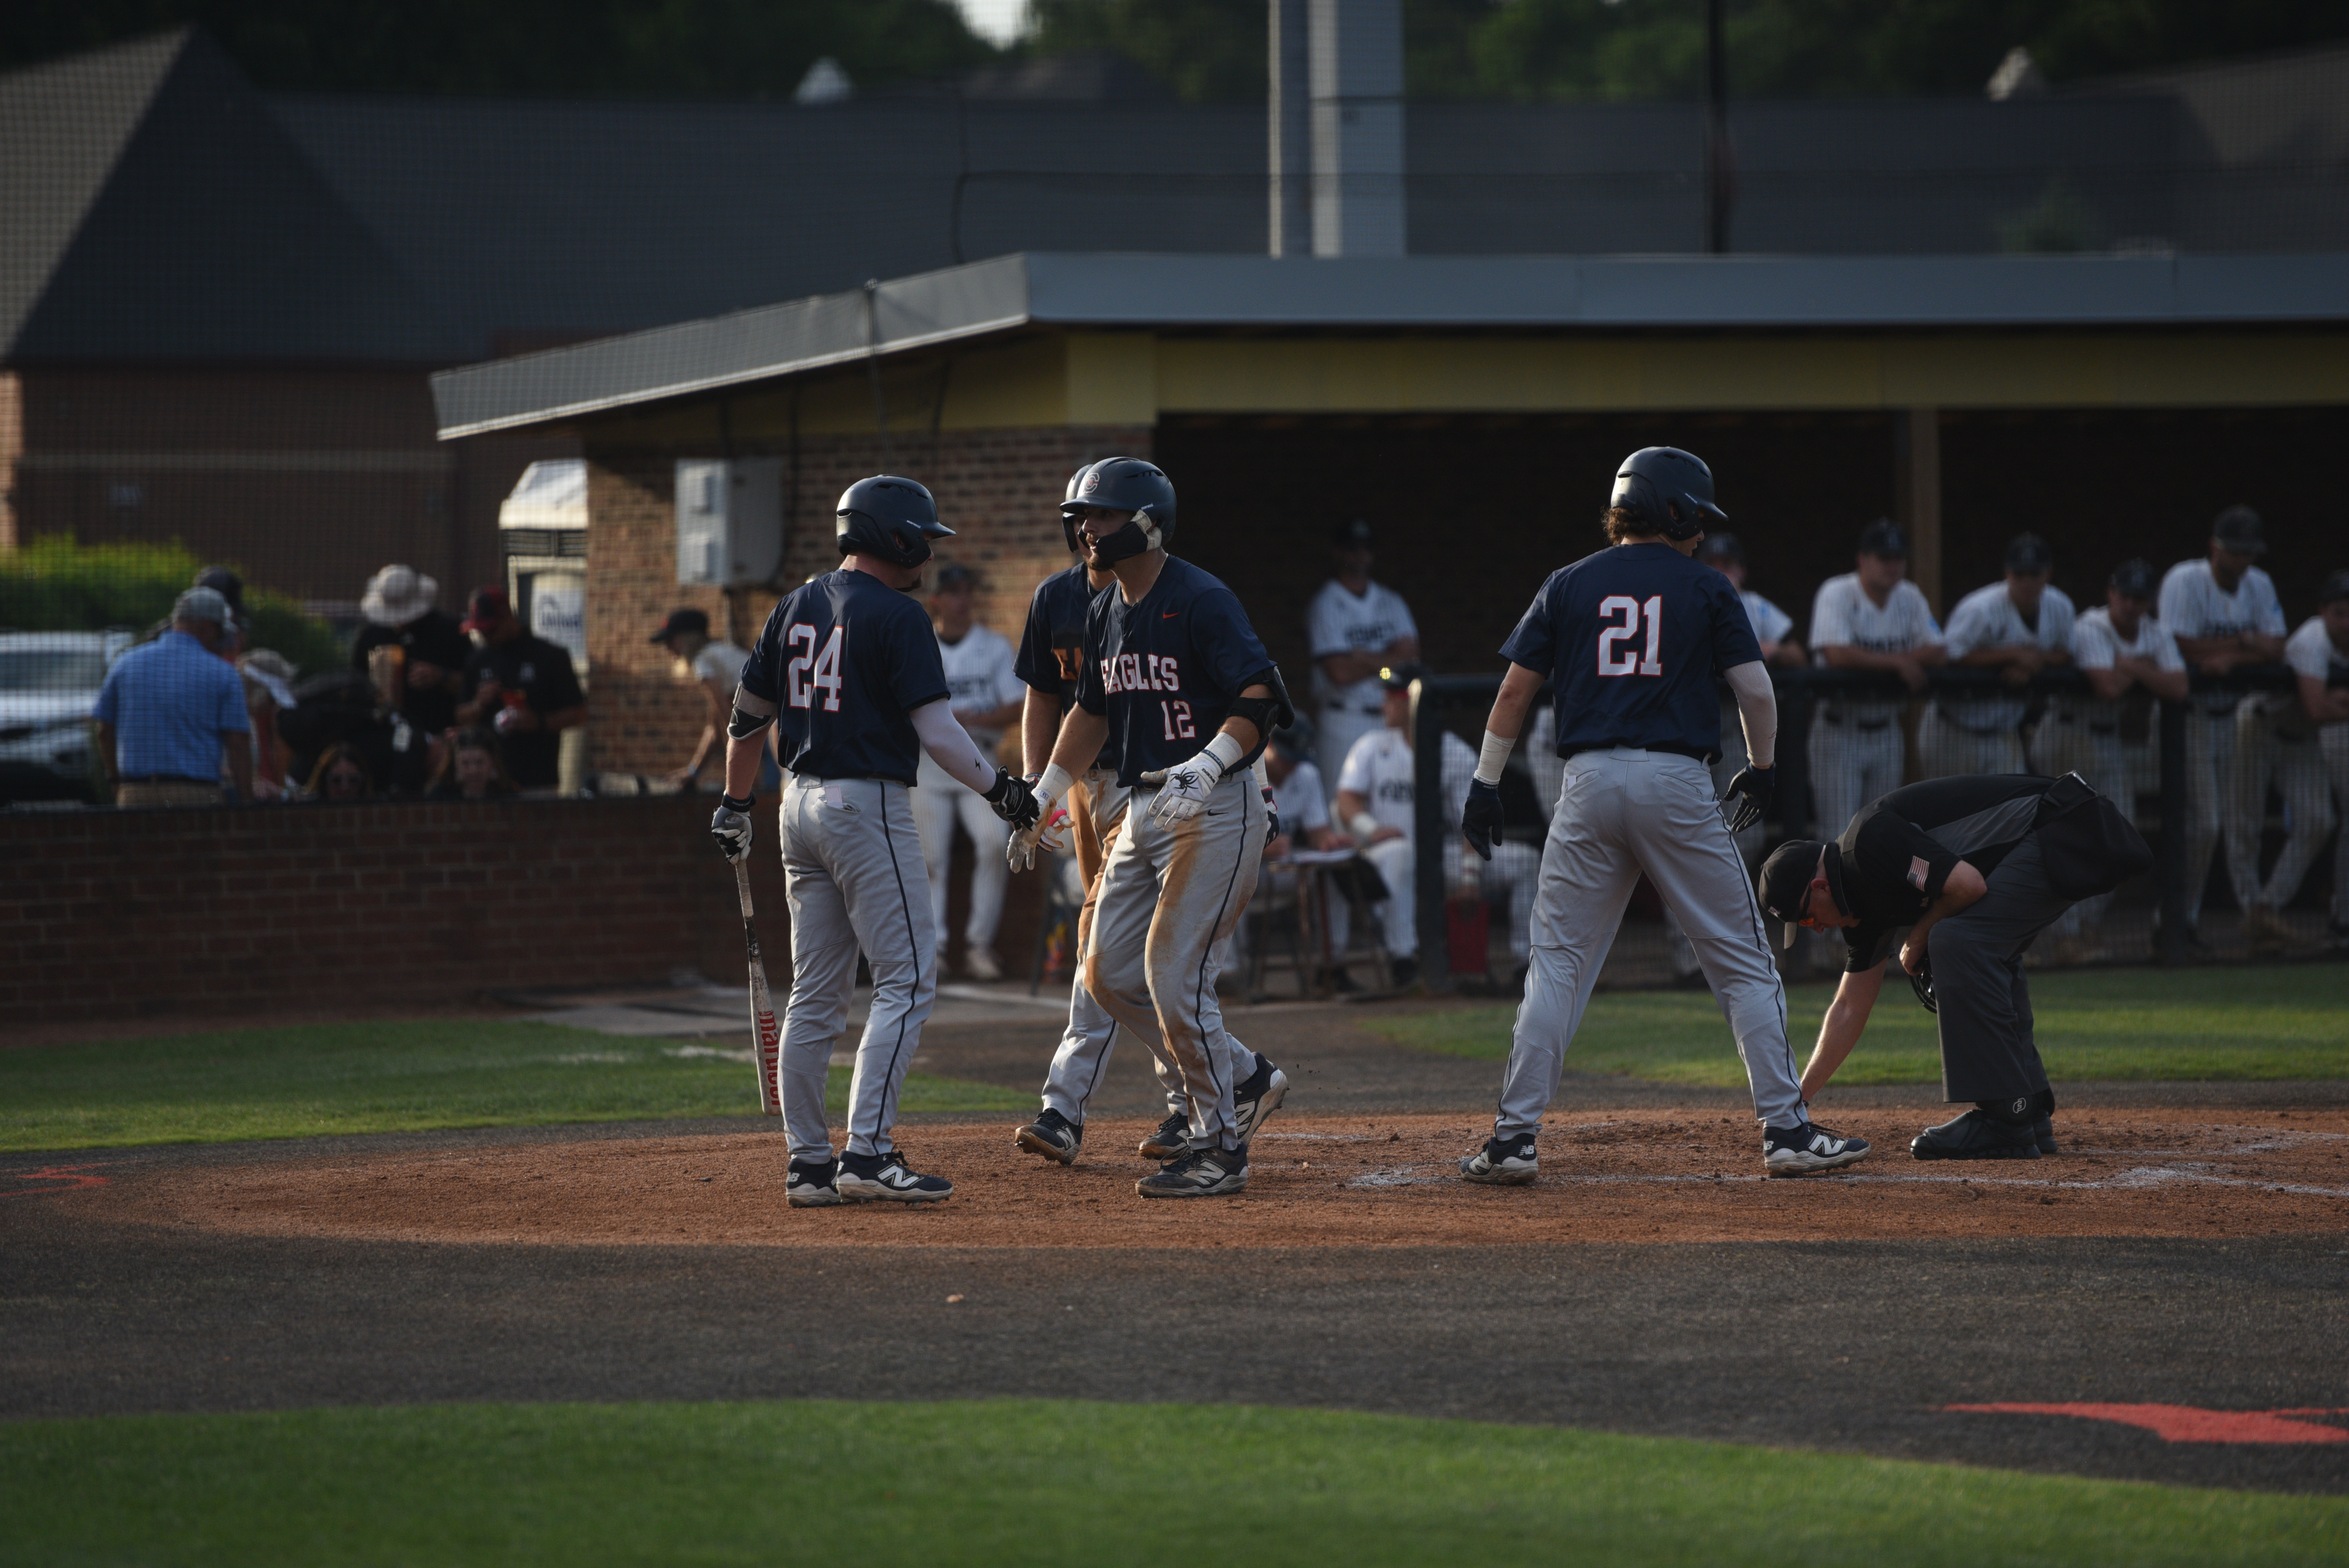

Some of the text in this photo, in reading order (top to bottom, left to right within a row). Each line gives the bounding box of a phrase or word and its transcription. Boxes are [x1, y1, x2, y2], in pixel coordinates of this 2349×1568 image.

[788, 622, 844, 712] 24
[1597, 593, 1664, 677] 21
[1160, 700, 1196, 741] 12
